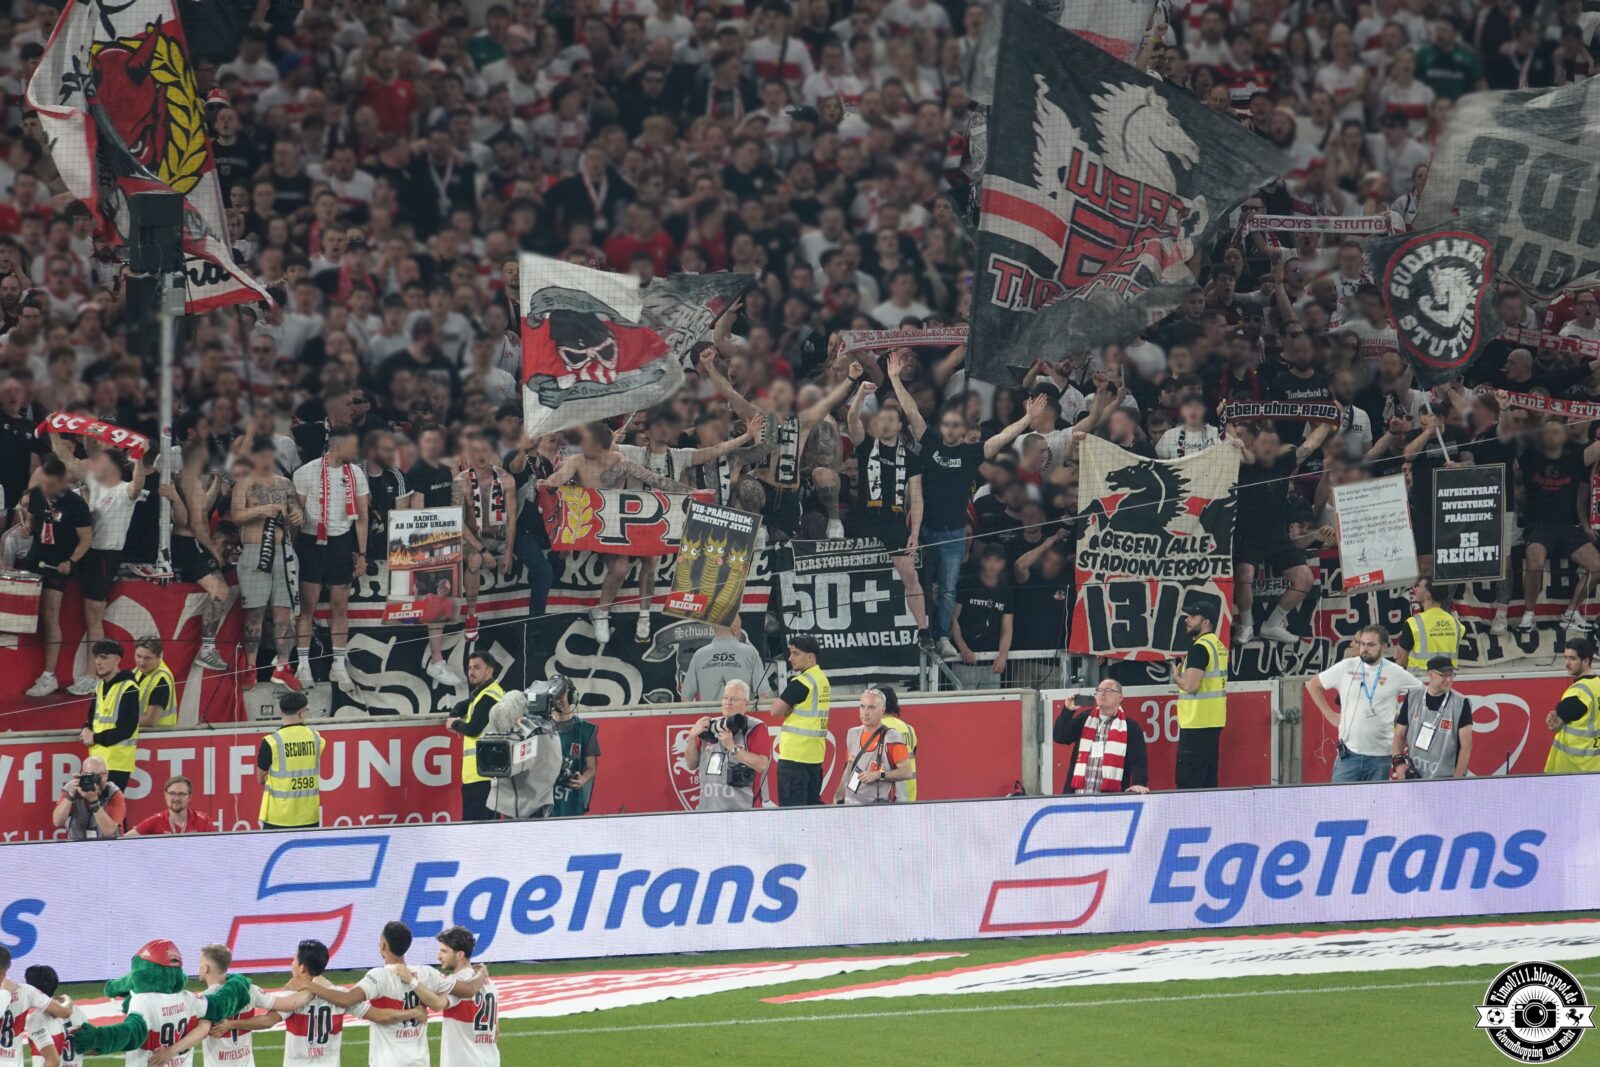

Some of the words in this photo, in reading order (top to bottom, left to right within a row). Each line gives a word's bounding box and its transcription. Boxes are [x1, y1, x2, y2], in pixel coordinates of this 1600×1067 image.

[1286, 389, 1321, 398] Timberland
[52, 414, 87, 430] CC
[111, 429, 145, 447] 97
[1437, 486, 1501, 497] AUFSICHTSRAT,
[1442, 499, 1497, 510] INVESTOREN,
[1101, 531, 1159, 555] GEGEN
[1169, 536, 1211, 554] ALLE
[1460, 532, 1479, 547] ES
[1078, 550, 1231, 576] STADIONVERBOTE
[1437, 546, 1499, 564] REICHT!
[669, 600, 702, 611] REICHT!
[388, 609, 424, 619] REICHT!
[712, 653, 736, 662] SDS
[1141, 700, 1181, 743] 36
[285, 741, 316, 757] SECURITY
[291, 776, 315, 790] 2598
[1149, 819, 1547, 924] EgeTrans
[400, 853, 807, 957] EgeTrans
[308, 1005, 331, 1044] 10
